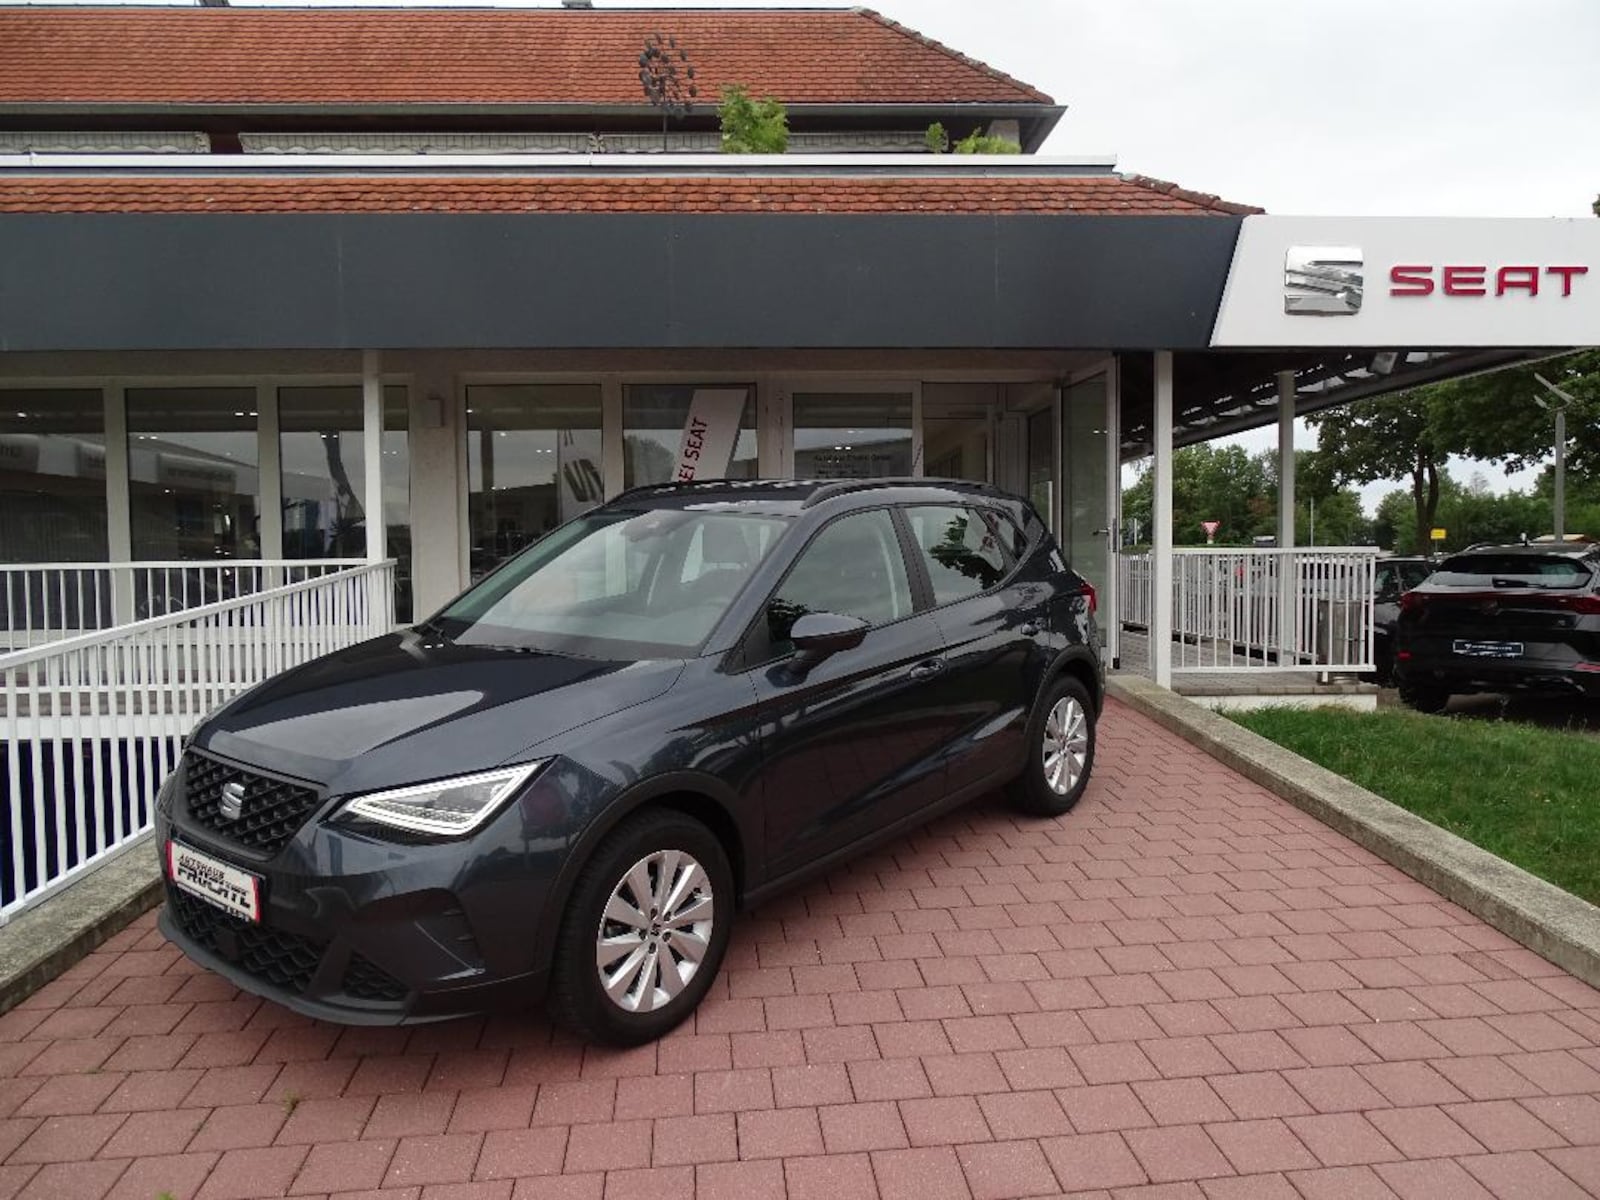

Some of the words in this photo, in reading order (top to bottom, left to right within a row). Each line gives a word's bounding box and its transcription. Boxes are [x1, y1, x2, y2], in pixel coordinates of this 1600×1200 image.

[1390, 265, 1589, 297] SEAT
[684, 416, 708, 461] SEAT
[679, 464, 696, 482] EI
